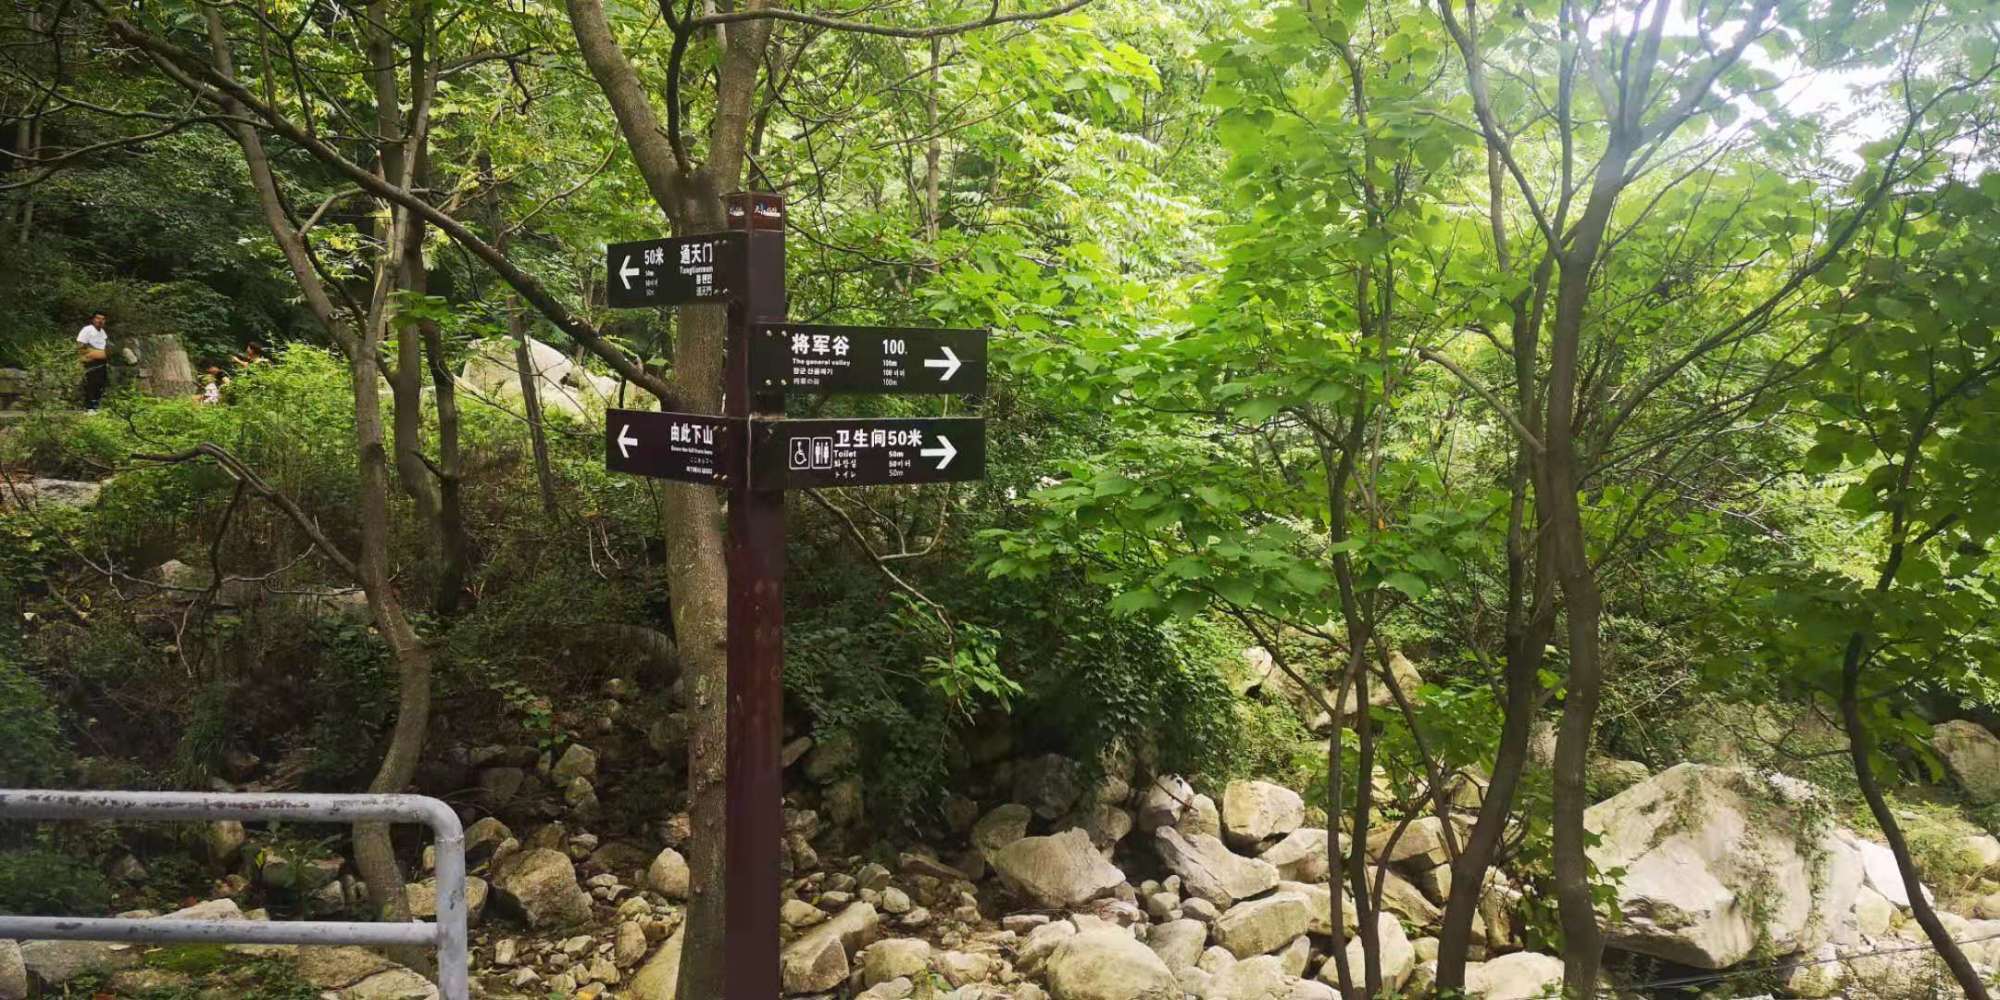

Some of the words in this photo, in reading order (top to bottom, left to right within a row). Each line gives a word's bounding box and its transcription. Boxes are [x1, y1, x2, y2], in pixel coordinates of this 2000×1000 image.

[644, 246, 664, 265] 50米
[680, 242, 713, 265] 通天门
[791, 333, 850, 356] 将军谷
[671, 421, 713, 445] 由此下山
[833, 449, 857, 458] Toilet
